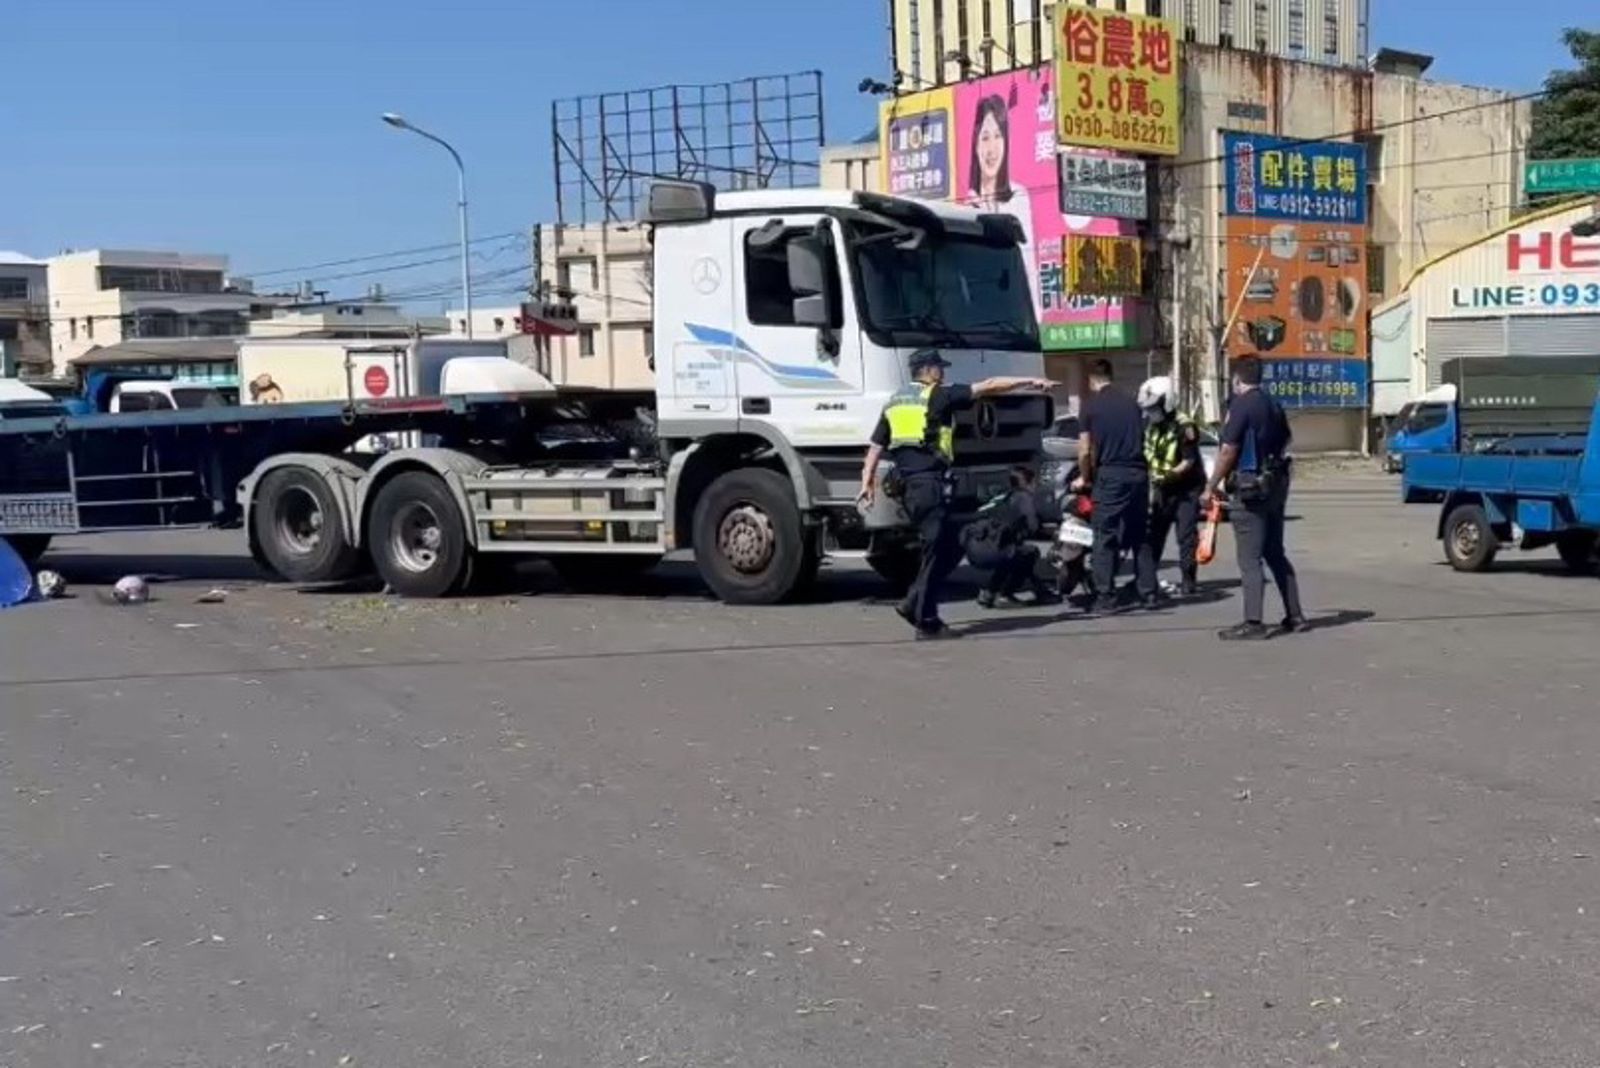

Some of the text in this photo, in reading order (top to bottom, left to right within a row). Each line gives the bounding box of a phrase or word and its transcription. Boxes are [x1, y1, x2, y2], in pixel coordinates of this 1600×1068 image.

[1062, 8, 1171, 75] 俗農地
[1064, 114, 1167, 144] 0930-085227
